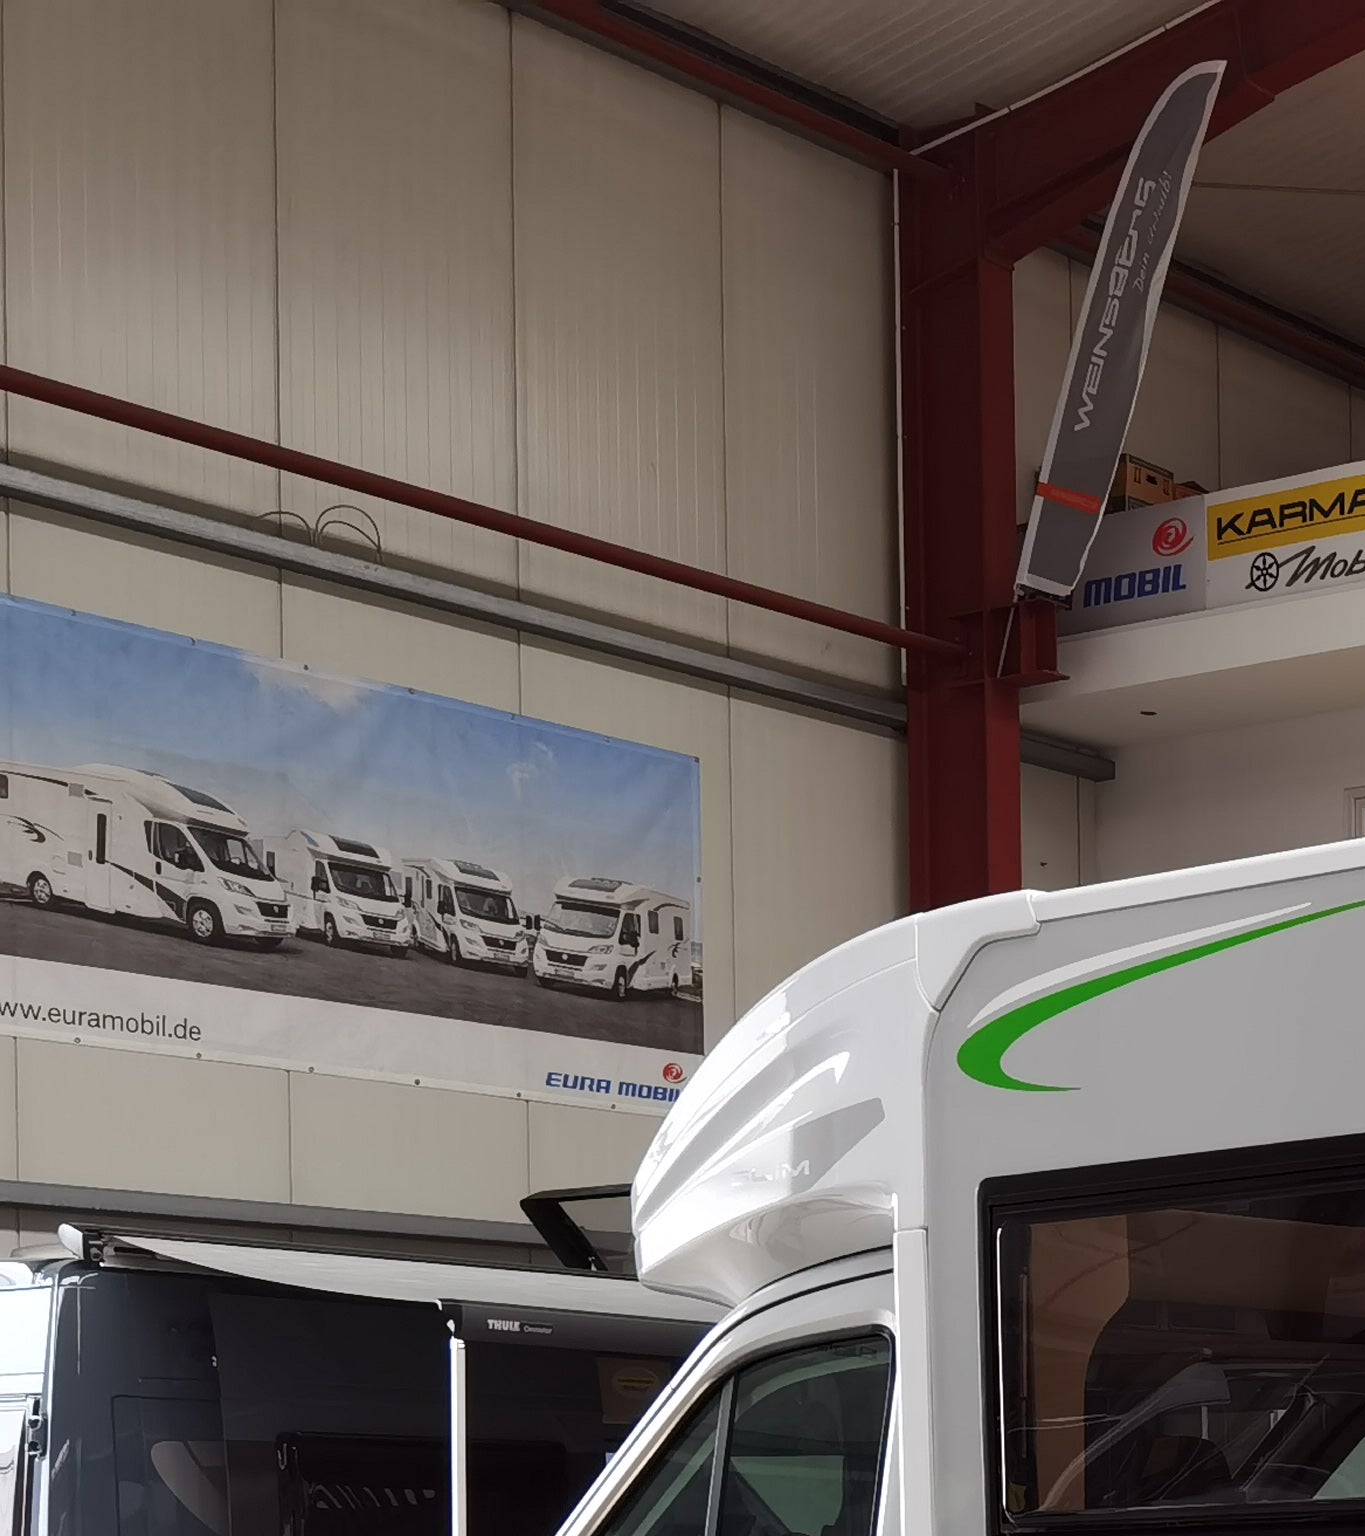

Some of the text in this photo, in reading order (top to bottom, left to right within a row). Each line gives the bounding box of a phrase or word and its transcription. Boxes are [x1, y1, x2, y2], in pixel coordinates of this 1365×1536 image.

[1074, 177, 1157, 432] WEINSBERG
[1083, 564, 1187, 608] MOBIL
[545, 1071, 612, 1094] EURA
[487, 1319, 520, 1332] THULE
